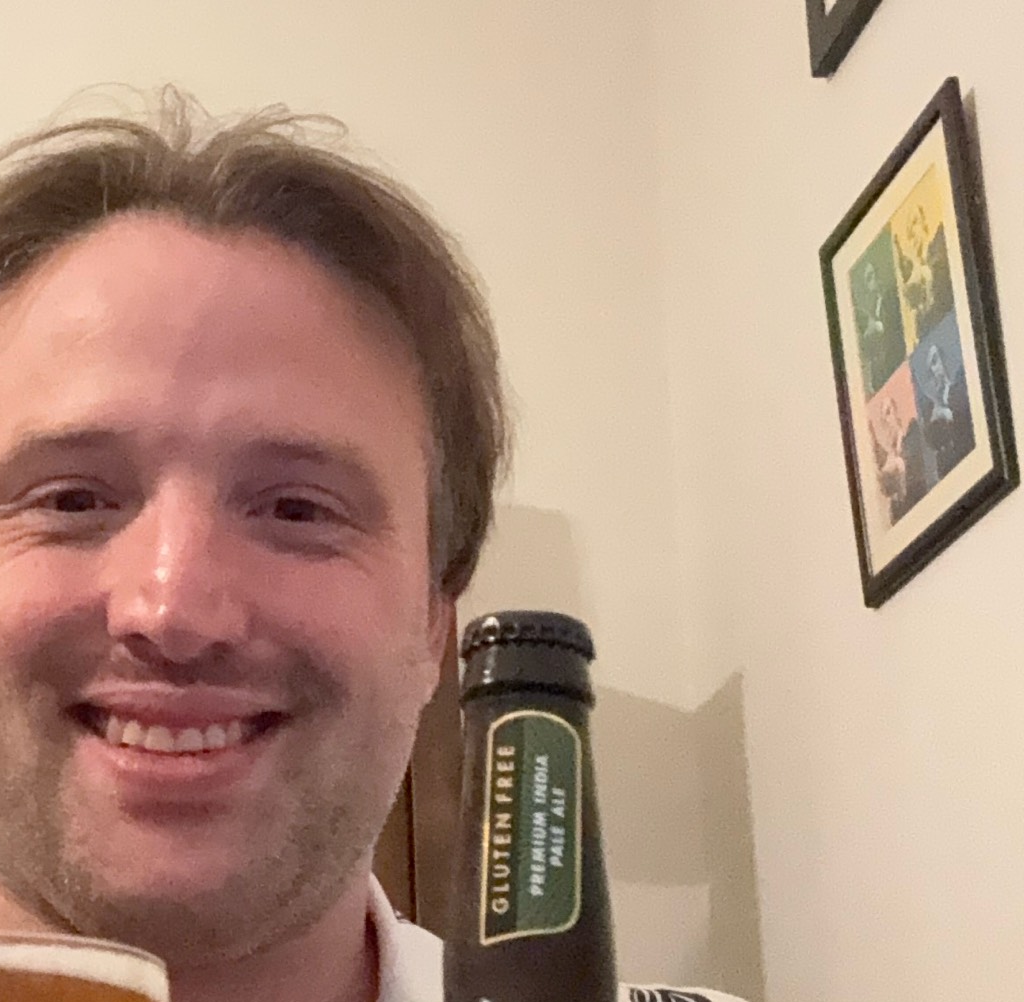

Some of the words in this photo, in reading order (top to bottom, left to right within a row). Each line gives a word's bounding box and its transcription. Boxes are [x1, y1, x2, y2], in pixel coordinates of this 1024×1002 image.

[495, 744, 516, 804] FREE
[534, 754, 550, 804] INDIA
[551, 787, 566, 819] ALE
[492, 812, 512, 915] GLUTEN
[529, 811, 547, 897] PREMIUM
[550, 825, 566, 867] PALE
